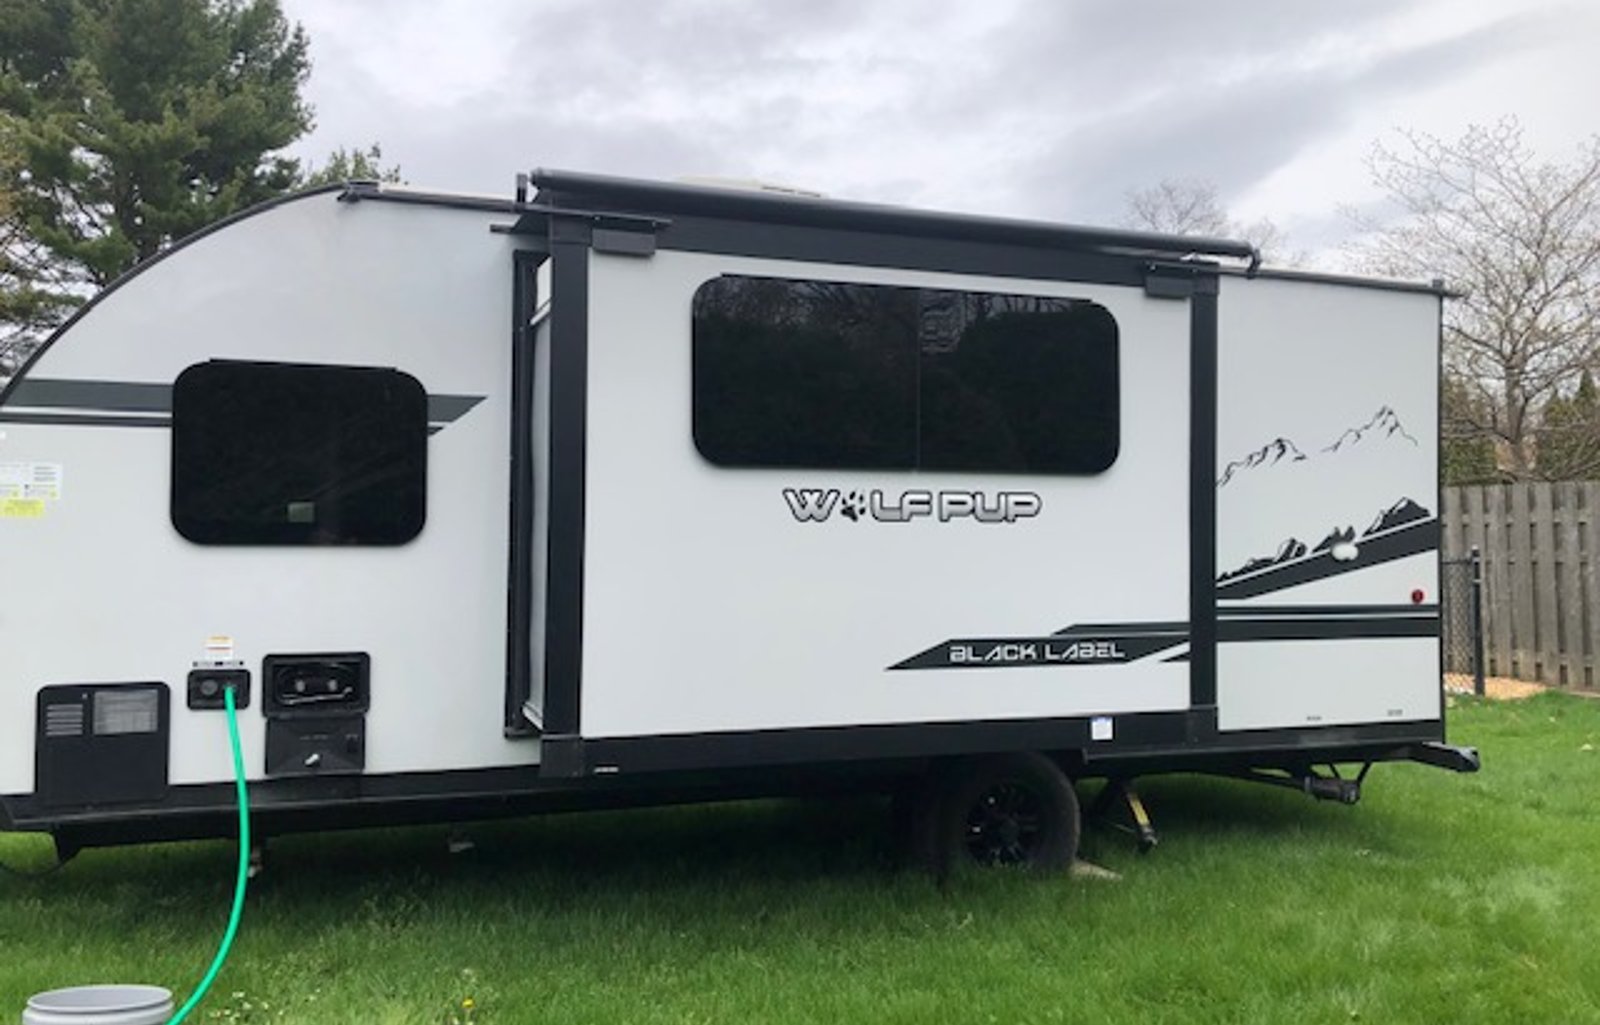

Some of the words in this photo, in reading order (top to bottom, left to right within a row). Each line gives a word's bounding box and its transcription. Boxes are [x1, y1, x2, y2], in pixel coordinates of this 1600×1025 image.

[782, 488, 932, 522] WLF
[939, 490, 1042, 523] PUP
[949, 644, 1037, 662] BLACK
[1044, 641, 1126, 660] LABEL
